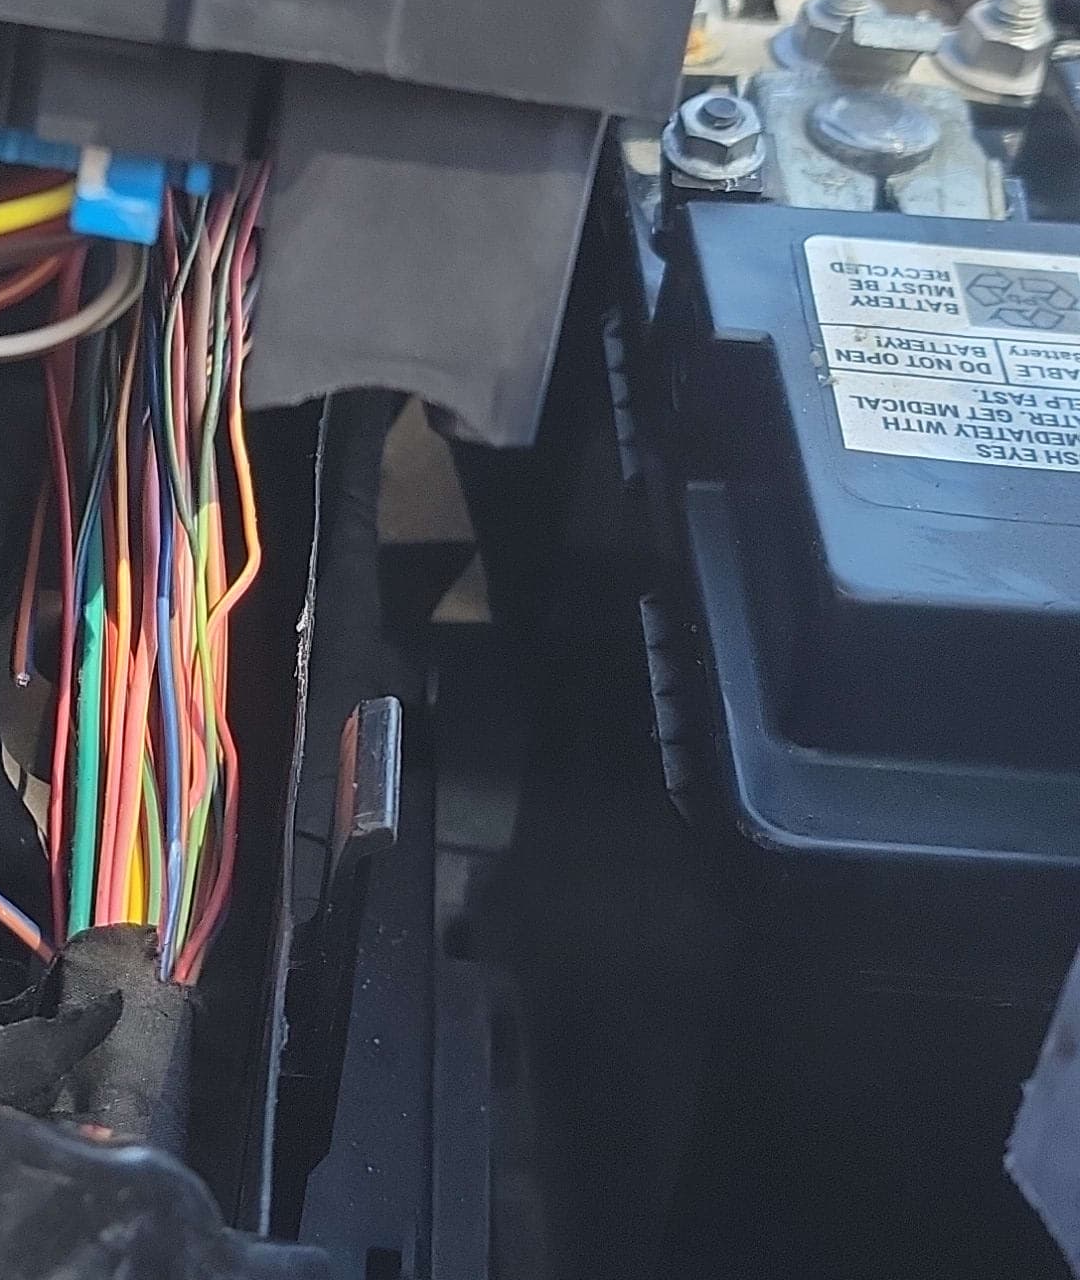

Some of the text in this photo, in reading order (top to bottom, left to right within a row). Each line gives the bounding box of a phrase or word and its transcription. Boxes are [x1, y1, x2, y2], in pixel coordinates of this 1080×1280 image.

[829, 261, 951, 282] RECYCLED
[849, 278, 955, 298] MUST BE
[850, 295, 960, 316] BATTERY
[875, 335, 986, 358] BATTERY!
[836, 348, 992, 376] DO NOT OPEN
[849, 395, 959, 419] MEDICAL
[972, 389, 1036, 408] FAST.
[966, 406, 1013, 424] GET
[881, 416, 947, 436] WITH
[976, 443, 1036, 461] EYES
